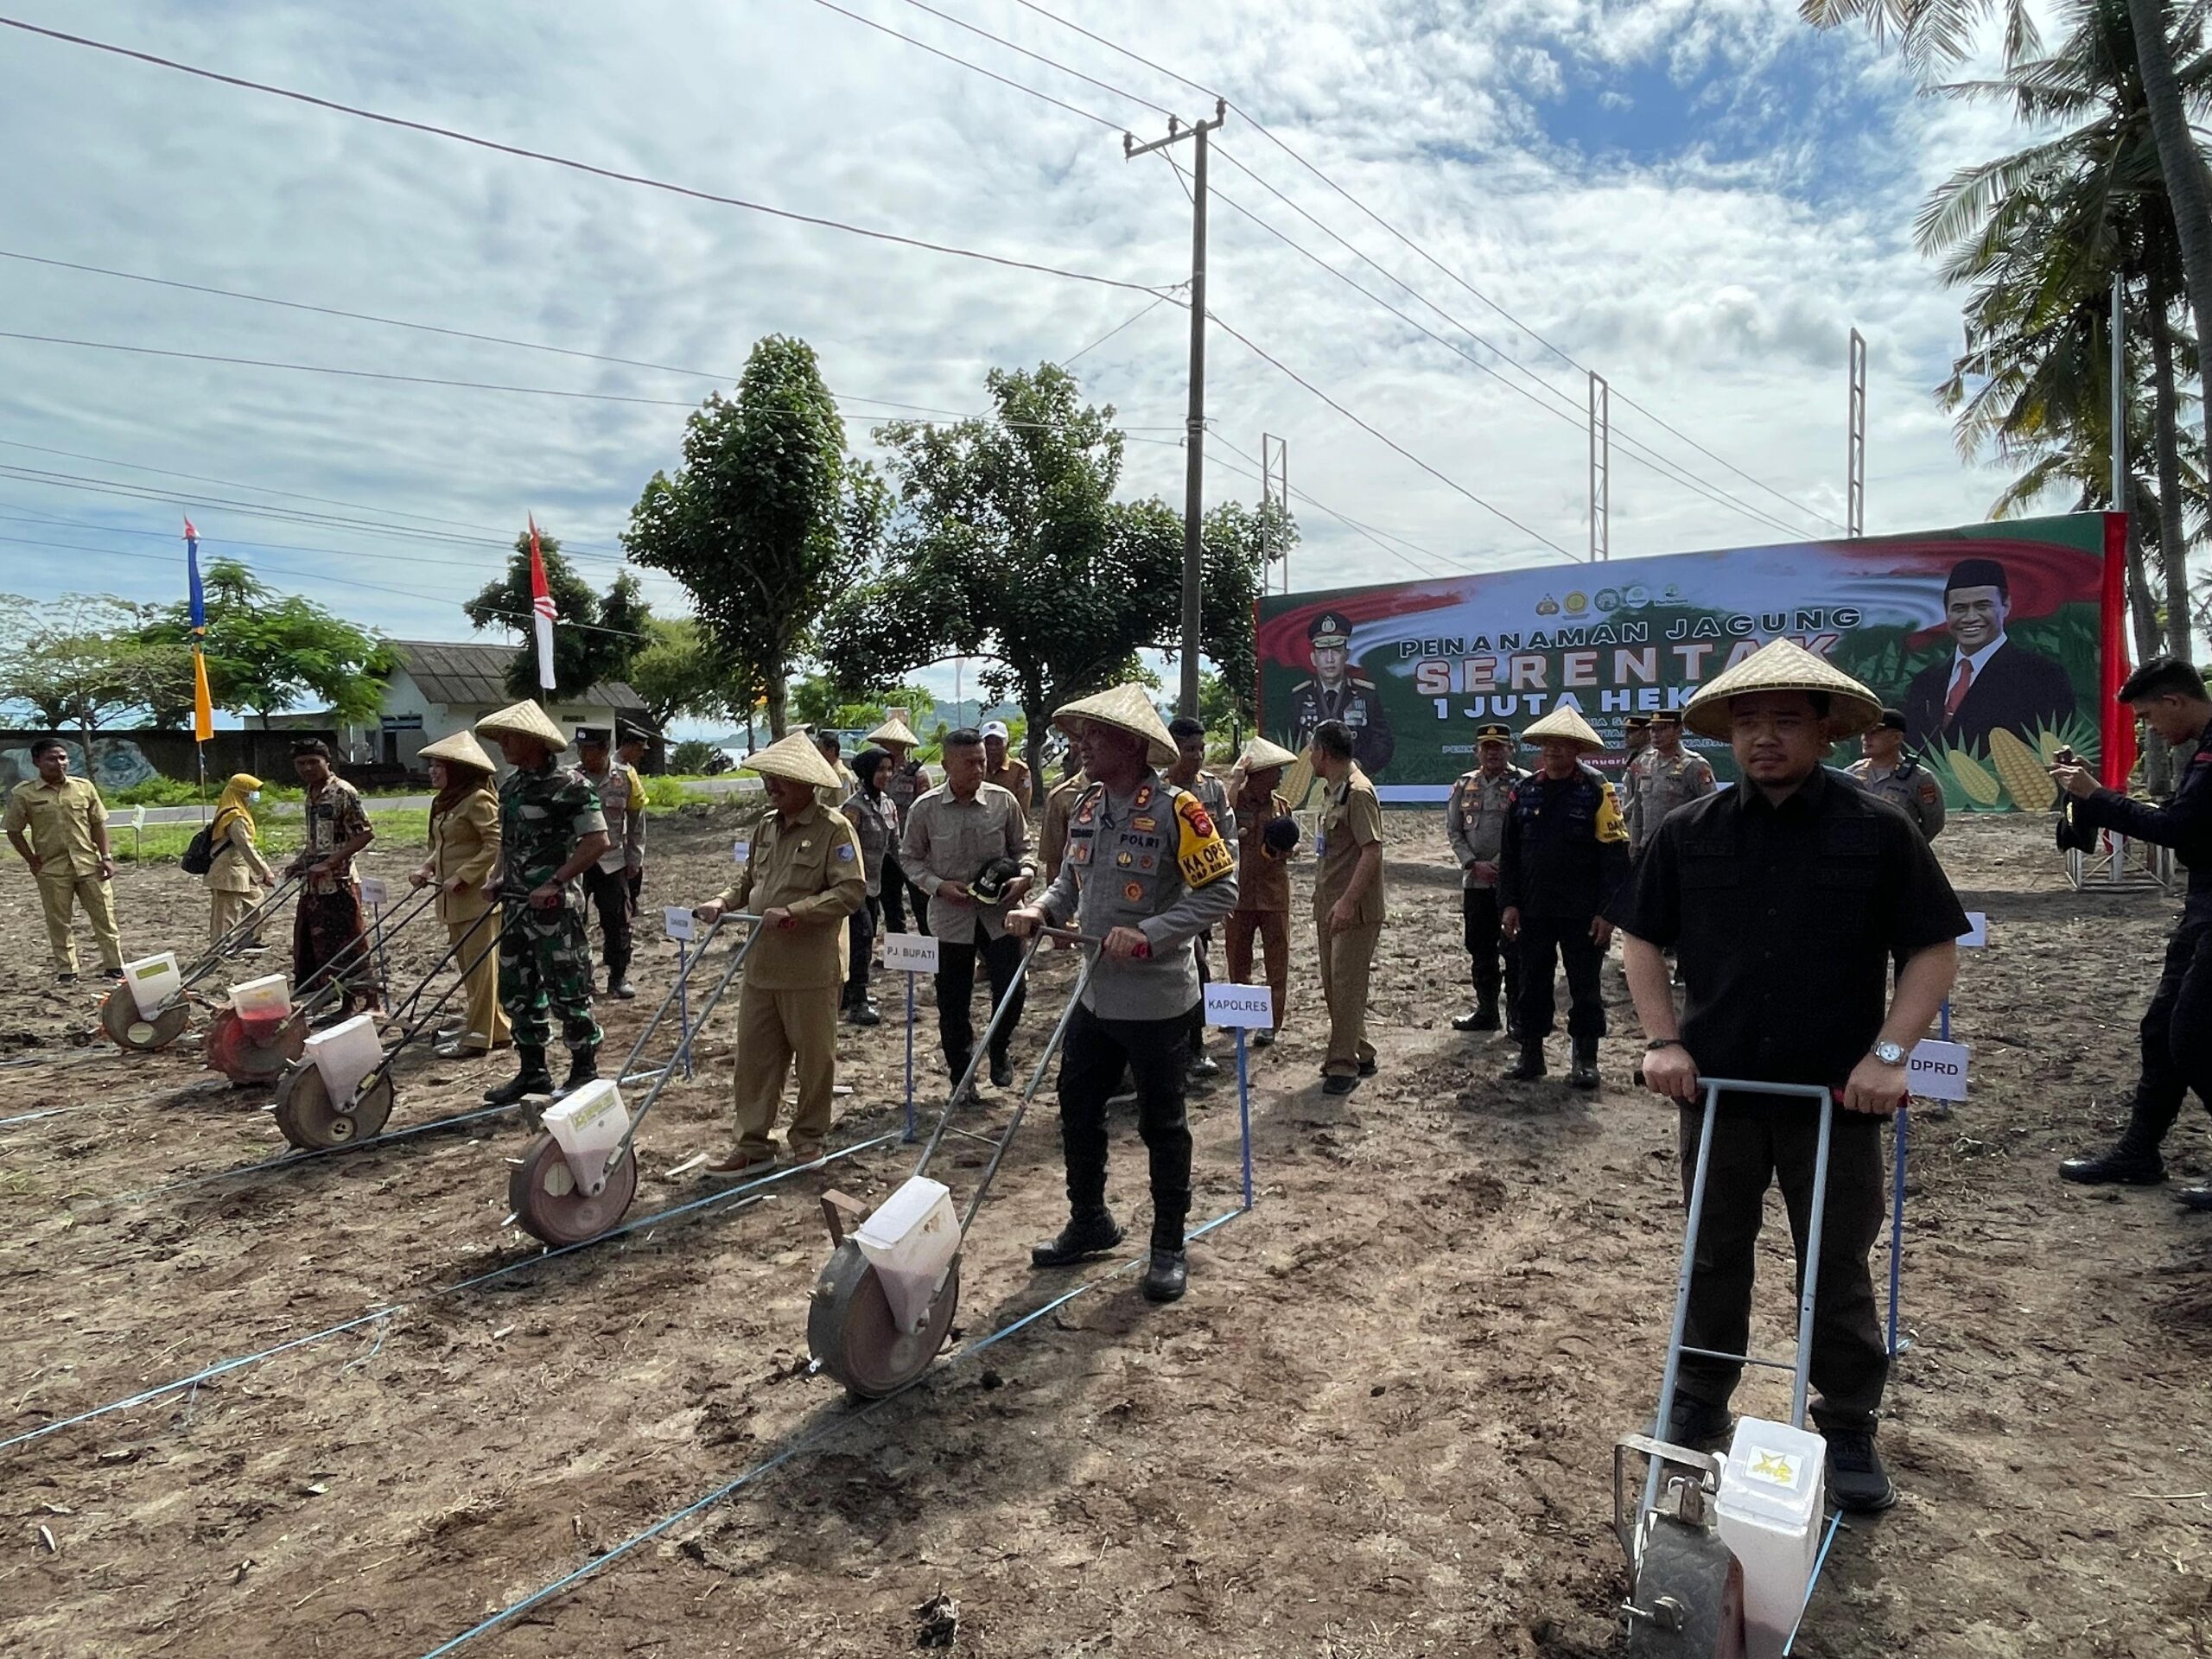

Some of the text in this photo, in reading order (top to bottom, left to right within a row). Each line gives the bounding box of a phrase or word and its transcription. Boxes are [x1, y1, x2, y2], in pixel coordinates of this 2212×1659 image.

[1400, 607, 1861, 658] PENANAMAN JAGUNG
[1415, 633, 1840, 695] SERENTAK
[1433, 685, 1699, 720] 1 JUTA HEK
[1120, 833, 1160, 849] POLRI
[1183, 842, 1225, 874] KA OPS
[887, 946, 935, 960] PJ. BUPATI
[1208, 1000, 1268, 1012] KAPOLRES
[1911, 1059, 1958, 1075] DPRD
